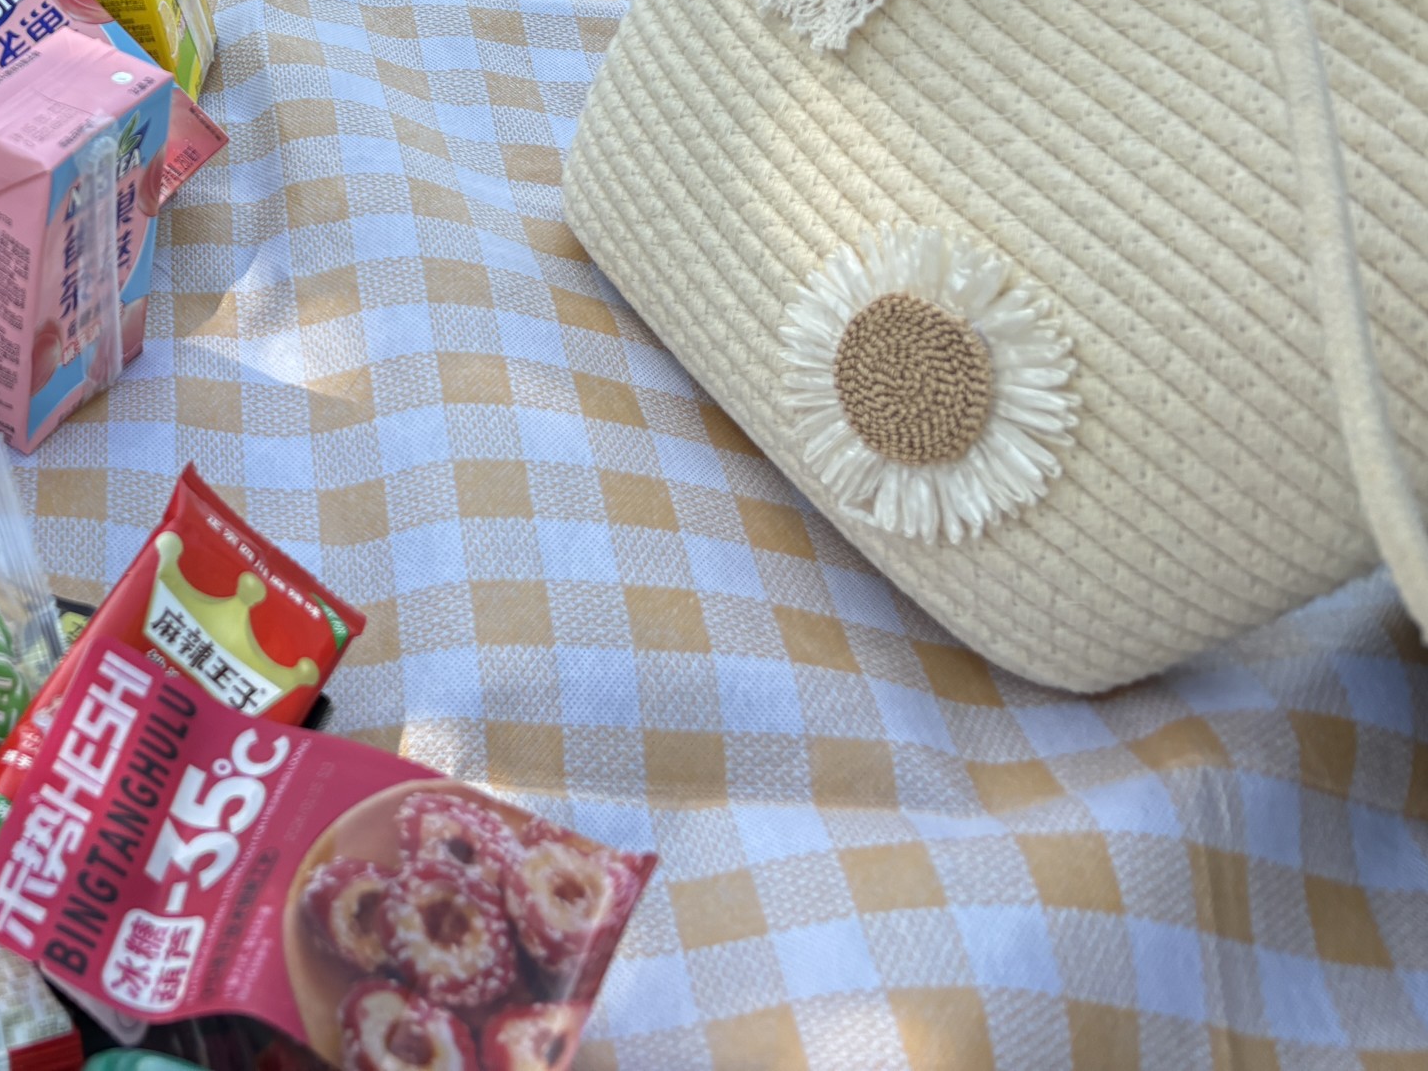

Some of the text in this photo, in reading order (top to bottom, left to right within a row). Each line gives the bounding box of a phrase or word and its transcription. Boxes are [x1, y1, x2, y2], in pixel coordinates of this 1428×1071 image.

[149, 605, 261, 713] 麻辣王子
[39, 649, 154, 825] HESHI
[39, 683, 200, 977] BINGTANGHULU
[109, 912, 168, 1000] 冰糖
